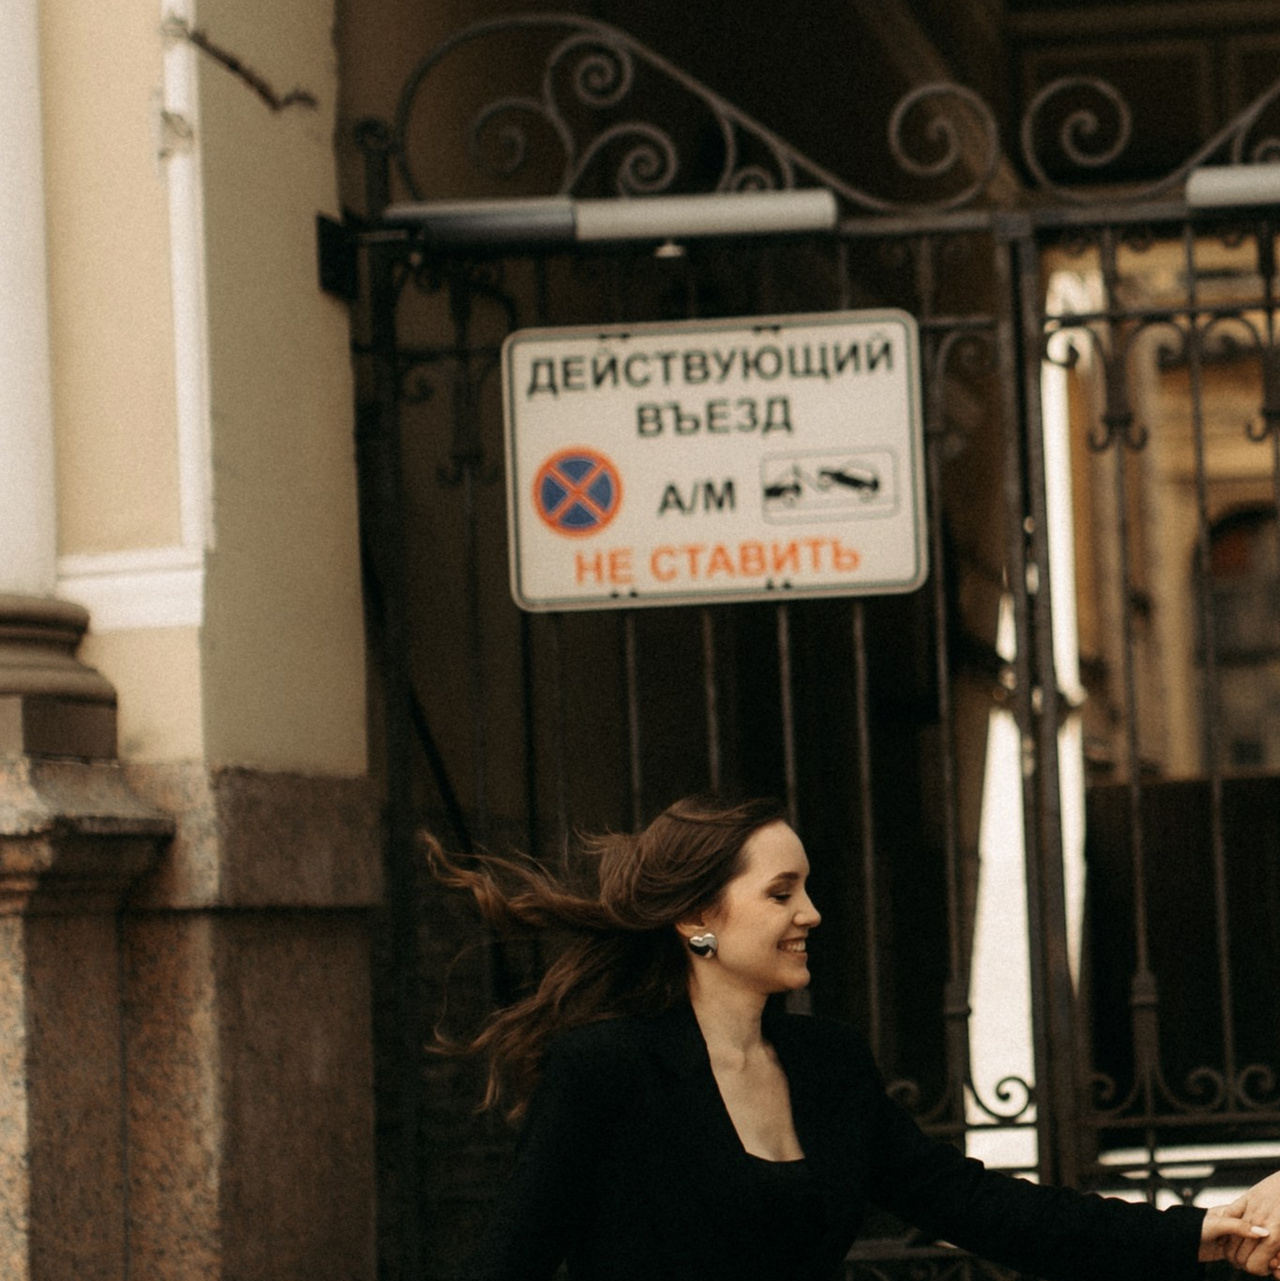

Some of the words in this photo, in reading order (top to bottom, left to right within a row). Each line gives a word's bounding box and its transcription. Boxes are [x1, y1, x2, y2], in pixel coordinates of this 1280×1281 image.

[527, 333, 893, 398] ДЕЙСТВУЮЩИЙ
[636, 396, 793, 437] ВЪЕЗД
[659, 480, 736, 516] А/М
[575, 548, 635, 585] НЕ
[650, 538, 861, 582] СТАВИТЬ
